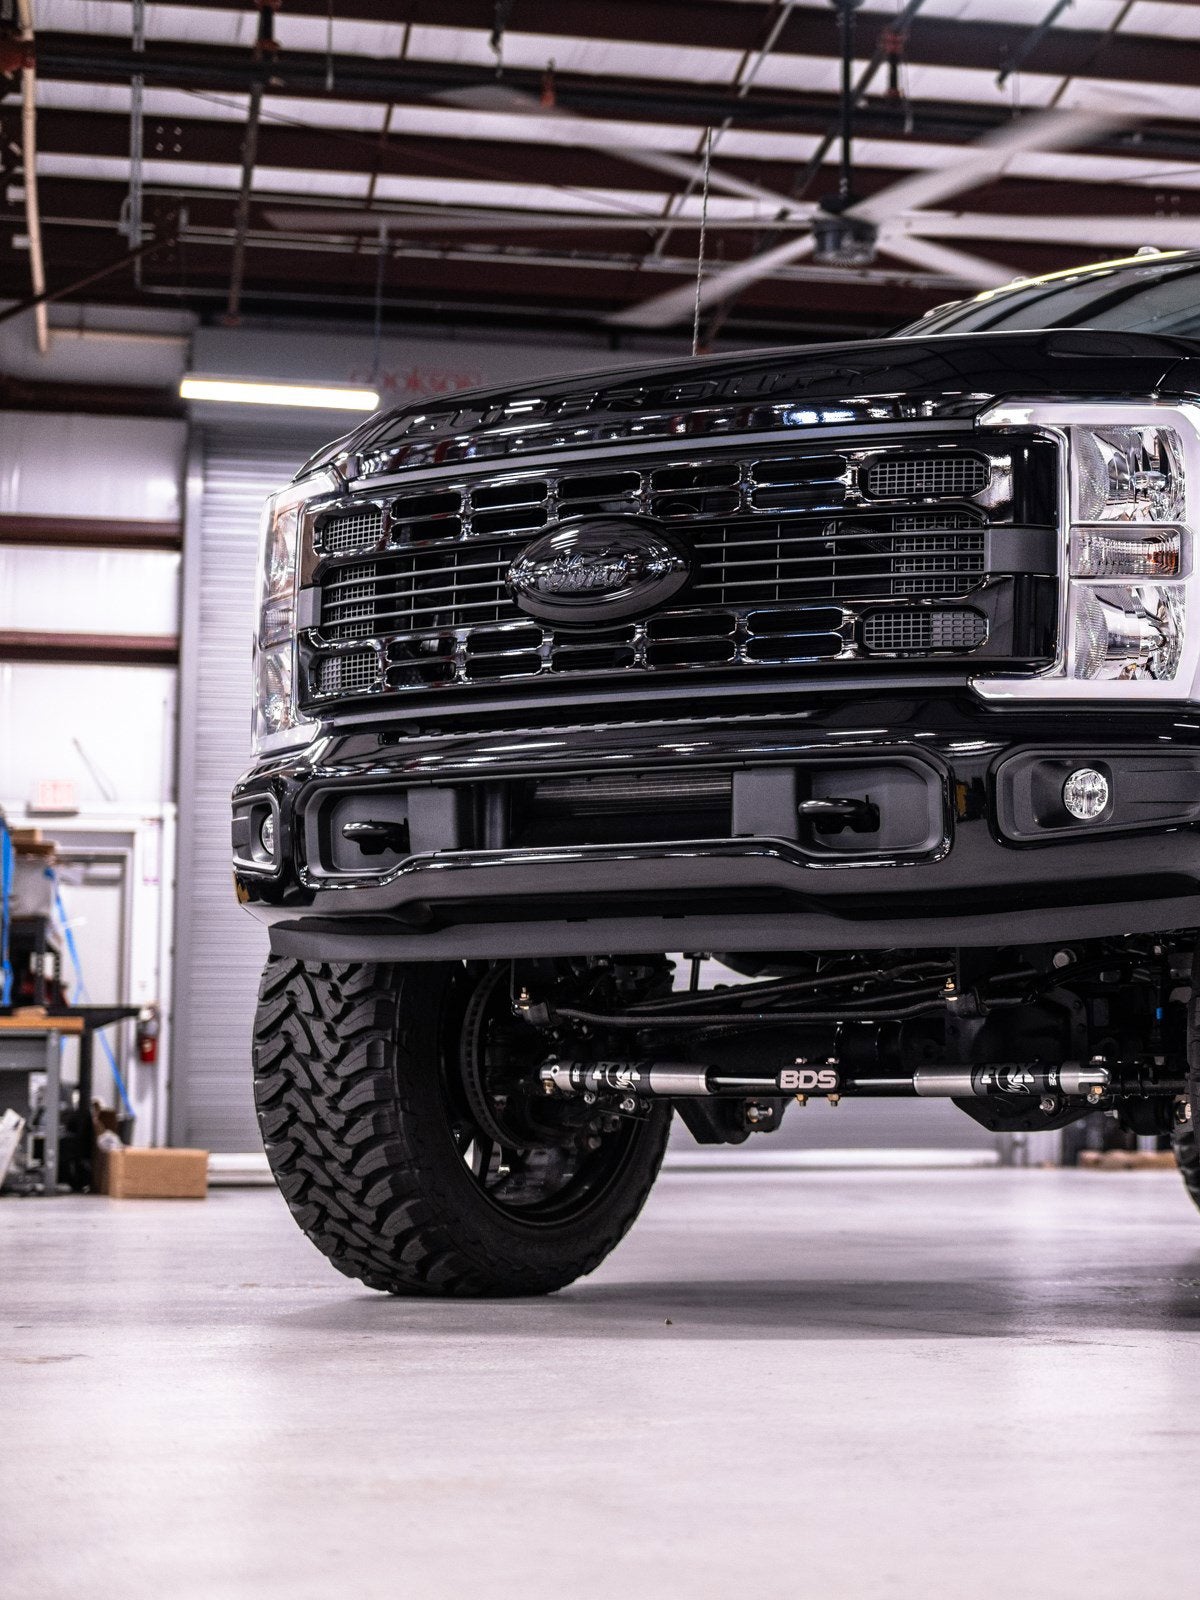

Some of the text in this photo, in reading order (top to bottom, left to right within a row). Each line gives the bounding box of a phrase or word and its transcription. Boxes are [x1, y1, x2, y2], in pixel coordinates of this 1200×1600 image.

[403, 365, 890, 435] SUPER DUTY
[538, 554, 631, 593] Ford
[592, 1061, 645, 1091] FOX
[779, 1069, 838, 1089] BDS
[980, 1062, 1038, 1093] FOX
